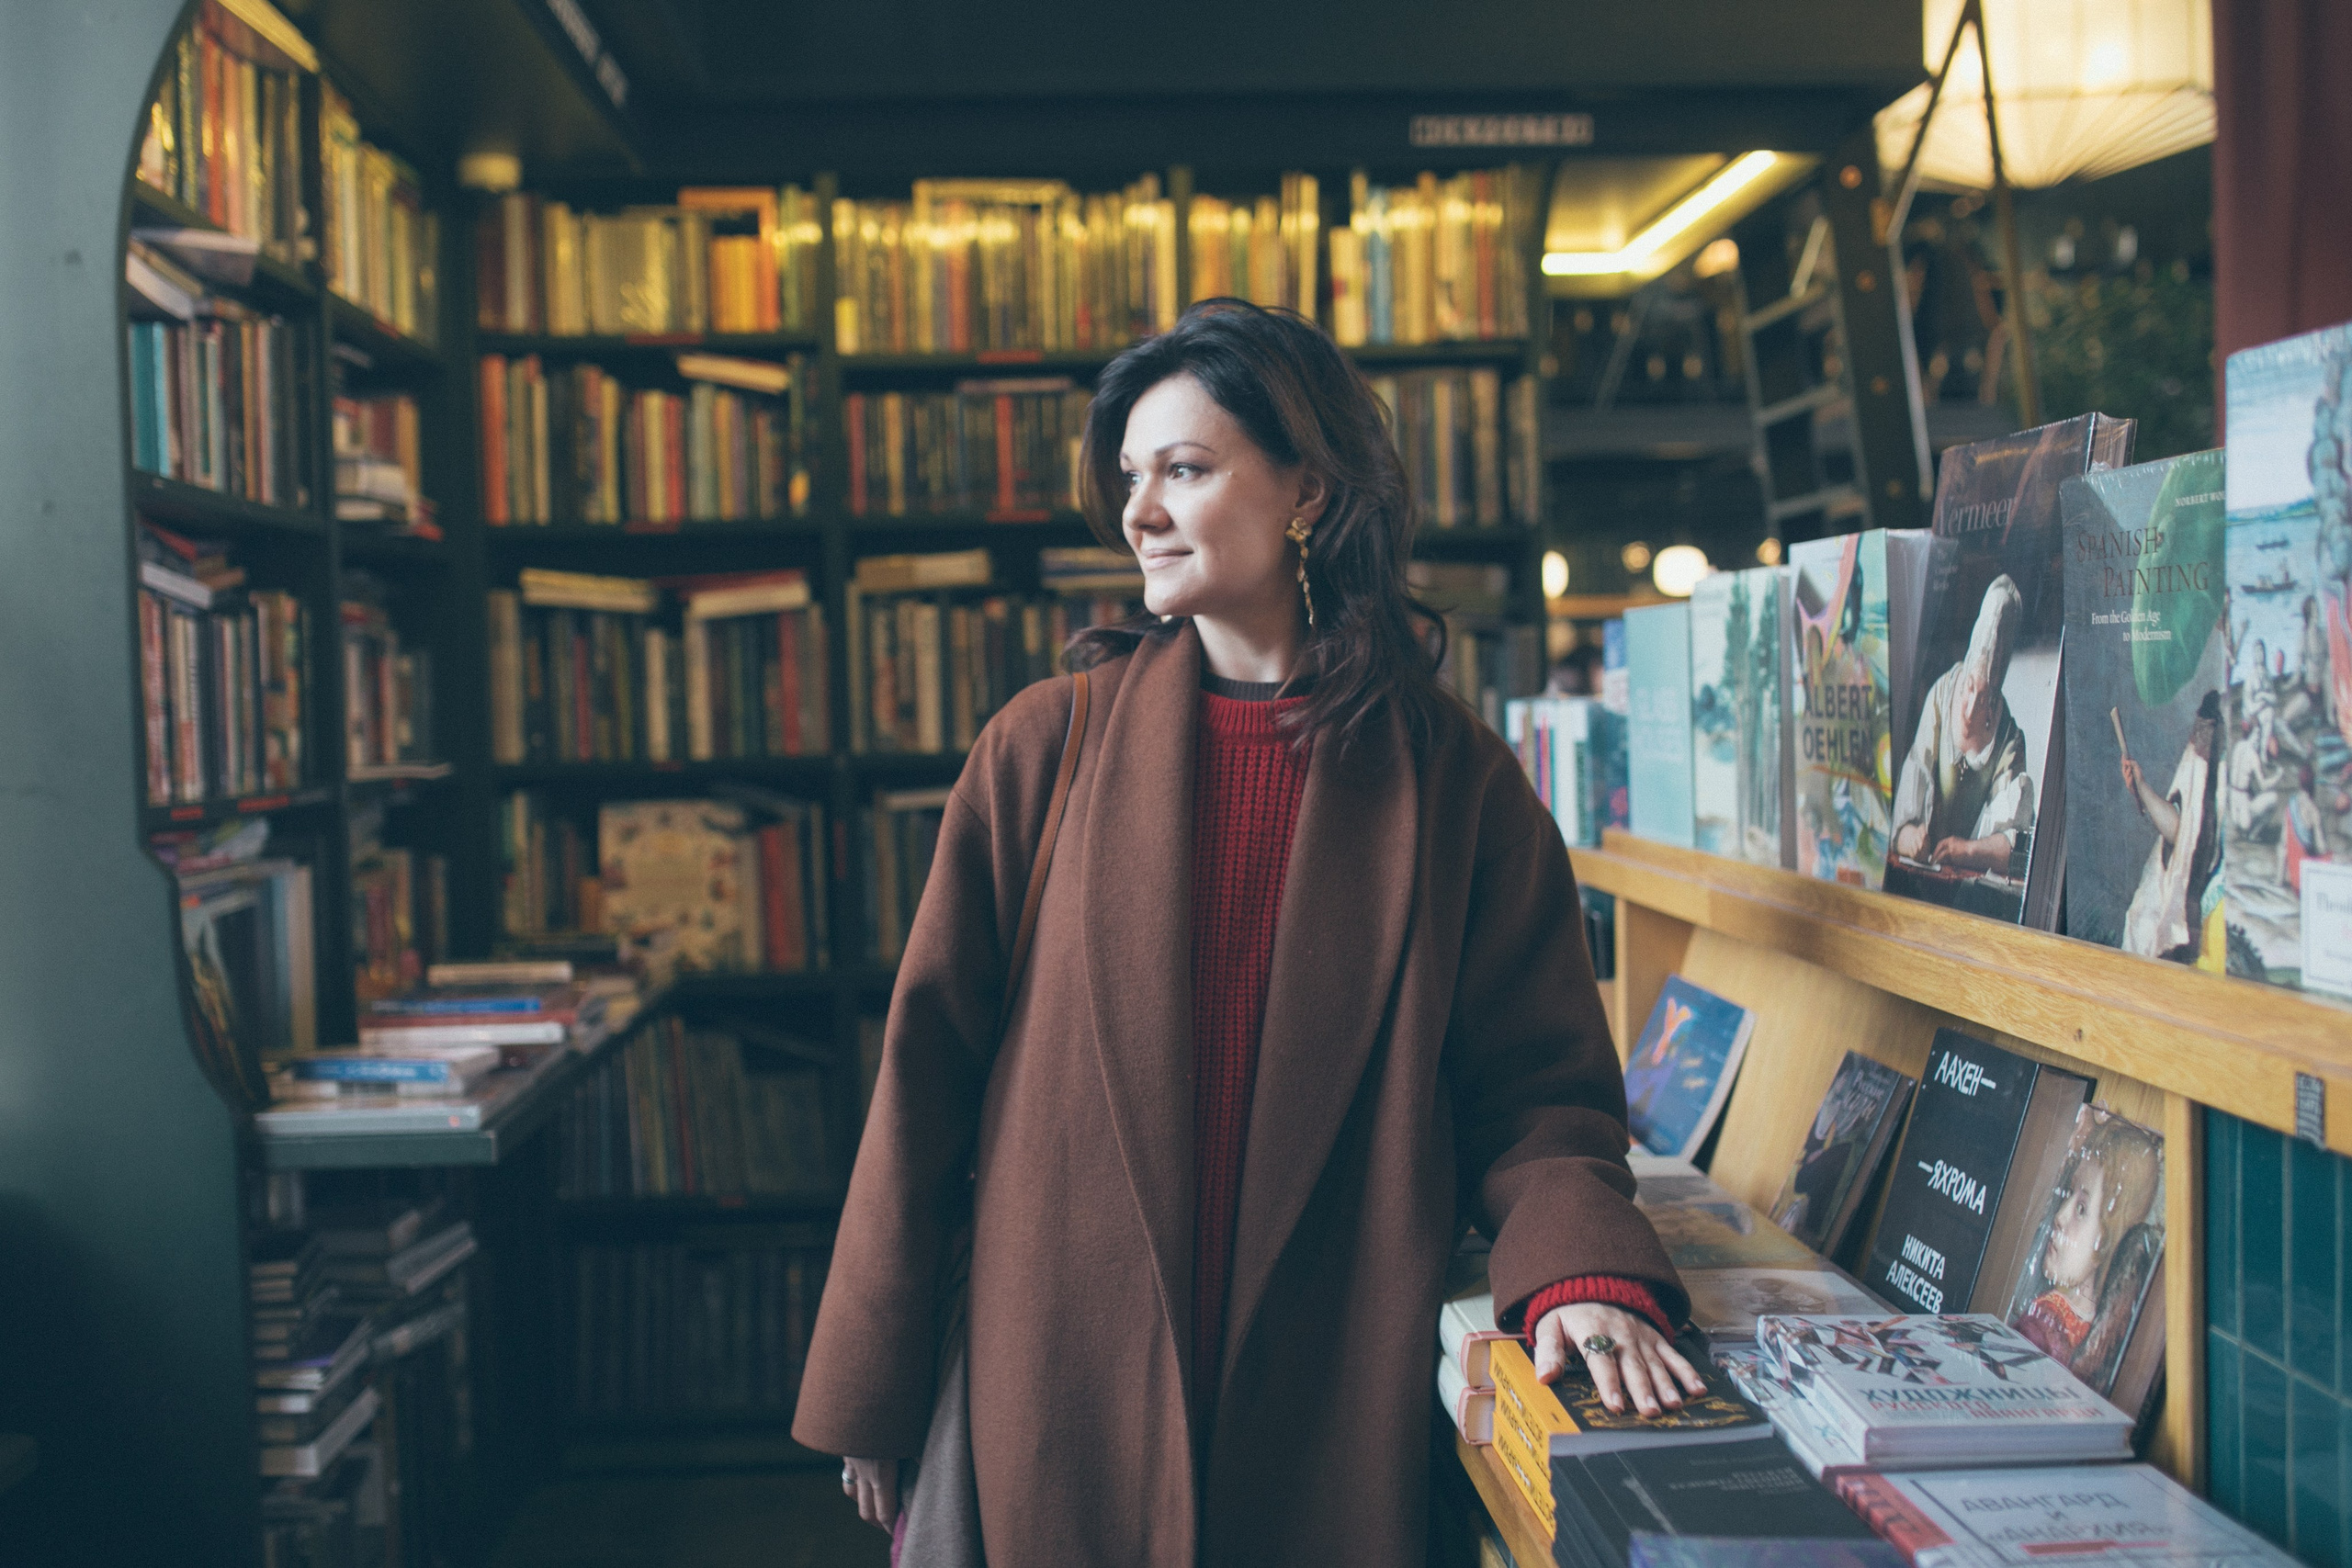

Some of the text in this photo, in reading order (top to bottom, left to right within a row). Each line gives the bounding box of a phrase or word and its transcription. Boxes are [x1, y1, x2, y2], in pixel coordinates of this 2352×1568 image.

[1936, 497, 2018, 536] Vermeer
[2175, 492, 2209, 507] NORBERT
[2076, 526, 2158, 563] SPANISH
[2104, 561, 2209, 597] PAINTING
[2091, 607, 2161, 627] From the Golden Age
[2122, 626, 2172, 642] to Modernism
[1804, 684, 1872, 720] ALBERT
[1803, 725, 1873, 768] OEHLEN
[1901, 1234, 1946, 1280] НИКИТА
[1885, 1259, 1944, 1314] АЛЕКСЕЕВ
[1961, 1492, 2132, 1513] АВАНГАРД
